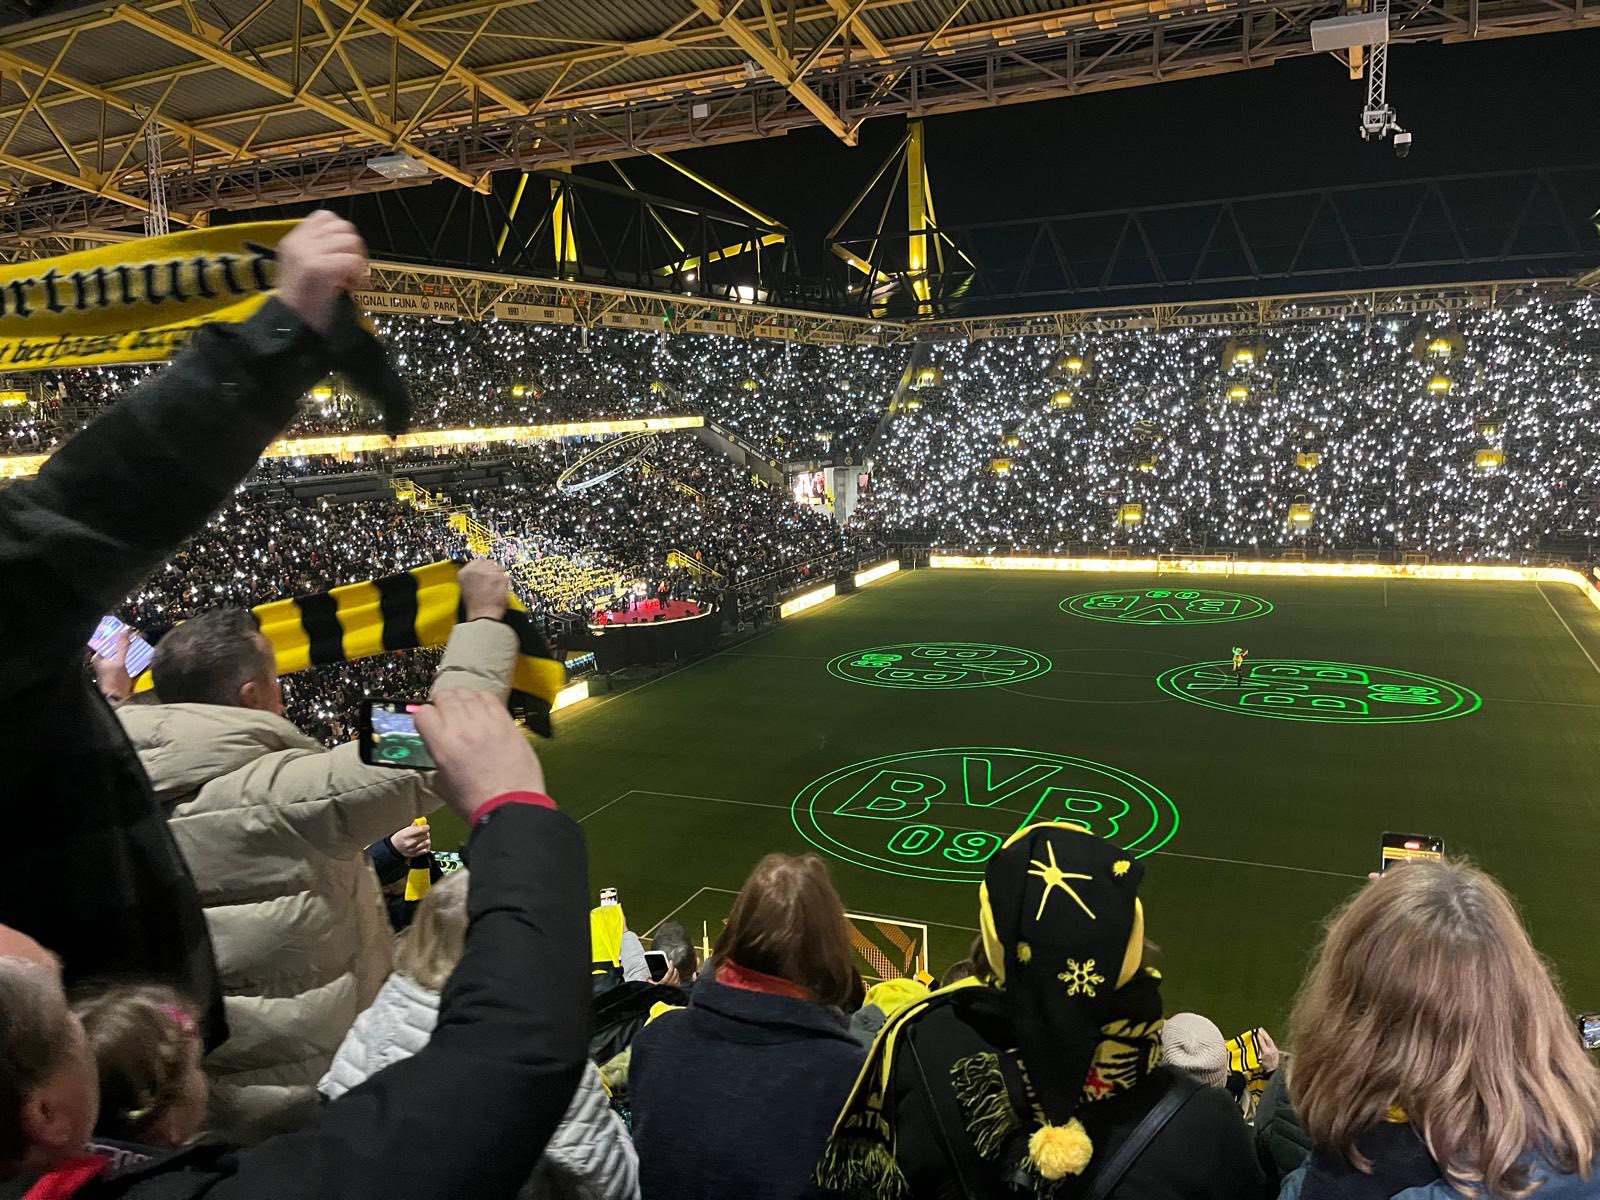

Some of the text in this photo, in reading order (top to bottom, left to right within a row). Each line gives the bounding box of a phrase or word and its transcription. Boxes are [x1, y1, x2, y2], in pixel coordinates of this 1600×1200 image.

[353, 293, 456, 312] SIGNAL IDUNA PARK
[1160, 307, 1311, 326] SÜDTRIBÜE
[990, 325, 1055, 337] GELBE
[1083, 595, 1241, 620] BVB
[833, 756, 1131, 839] BVB
[887, 824, 1003, 864] 09
